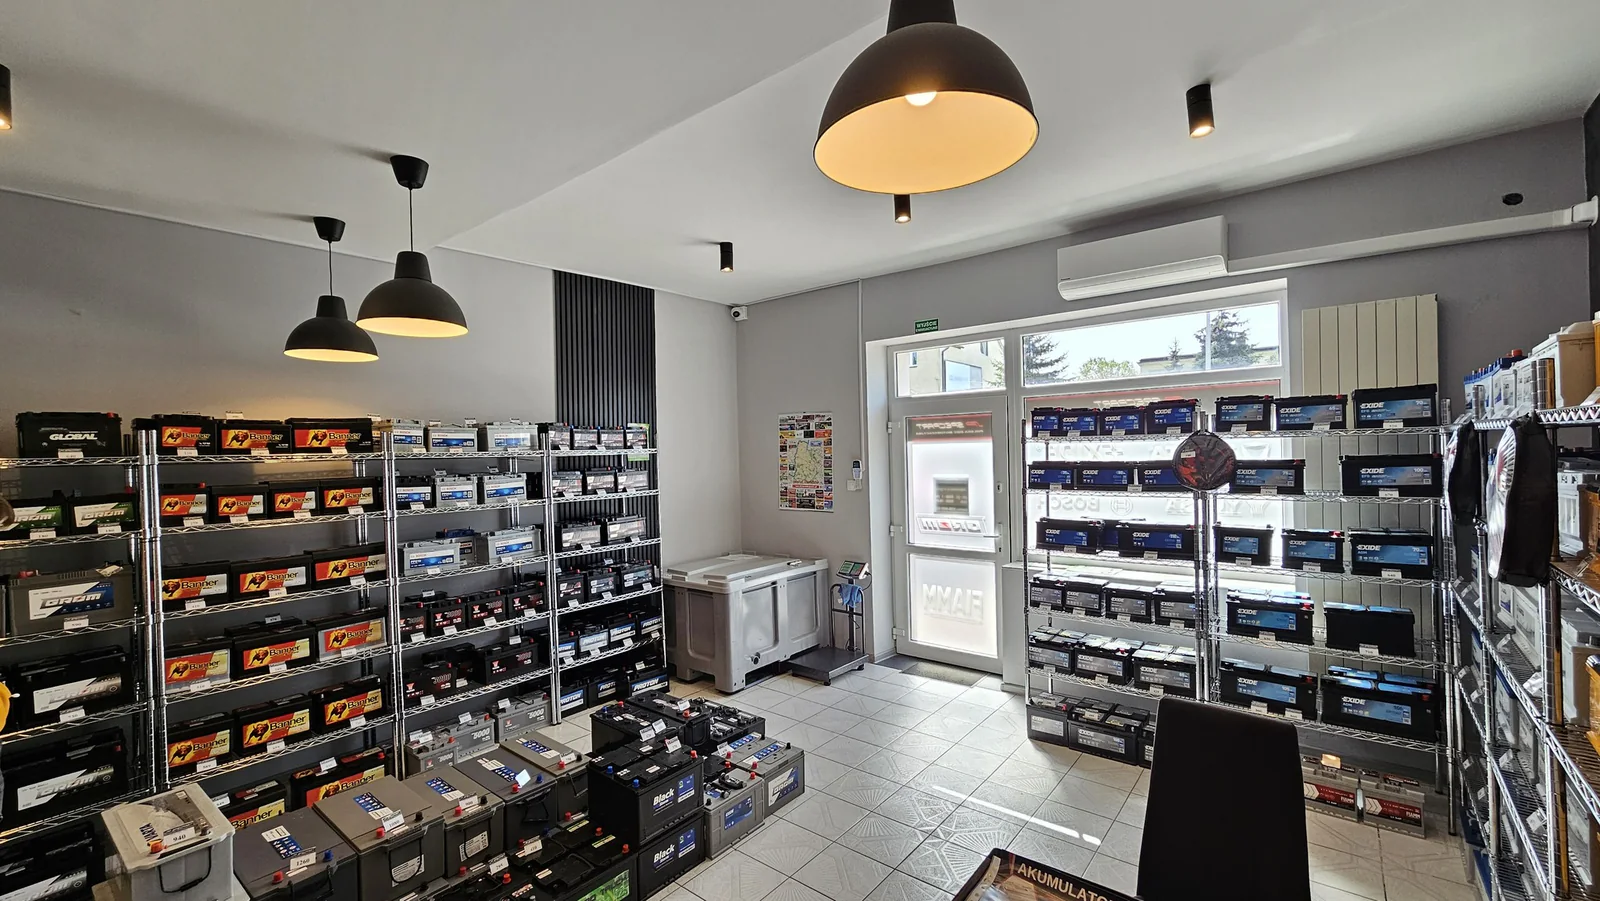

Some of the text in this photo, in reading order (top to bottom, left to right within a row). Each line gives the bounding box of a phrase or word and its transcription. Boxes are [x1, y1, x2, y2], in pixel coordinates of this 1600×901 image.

[1360, 401, 1385, 409] EXIDE
[49, 433, 98, 441] GLOBAL
[182, 432, 211, 440] Banner
[250, 433, 284, 441] Banner
[329, 431, 362, 441] Banner
[345, 491, 372, 499] Banner
[179, 499, 204, 507] Banner
[236, 500, 262, 508] Banner
[348, 558, 380, 568] Banner
[266, 571, 299, 581] Banner
[181, 578, 219, 589] Banner
[1236, 608, 1258, 616] EXIDE
[346, 627, 374, 638] Banner
[269, 644, 301, 656] Banner
[189, 659, 220, 671] Banner
[1237, 677, 1259, 686] EXIDE
[347, 694, 379, 709] Banner
[1341, 696, 1366, 705] EXIDE
[270, 715, 306, 731] Banner
[193, 737, 228, 751] Banner
[341, 773, 375, 790] Banner
[653, 787, 675, 806] Black
[172, 834, 186, 843] 940
[653, 844, 675, 863] Black
[296, 858, 310, 867] 1260
